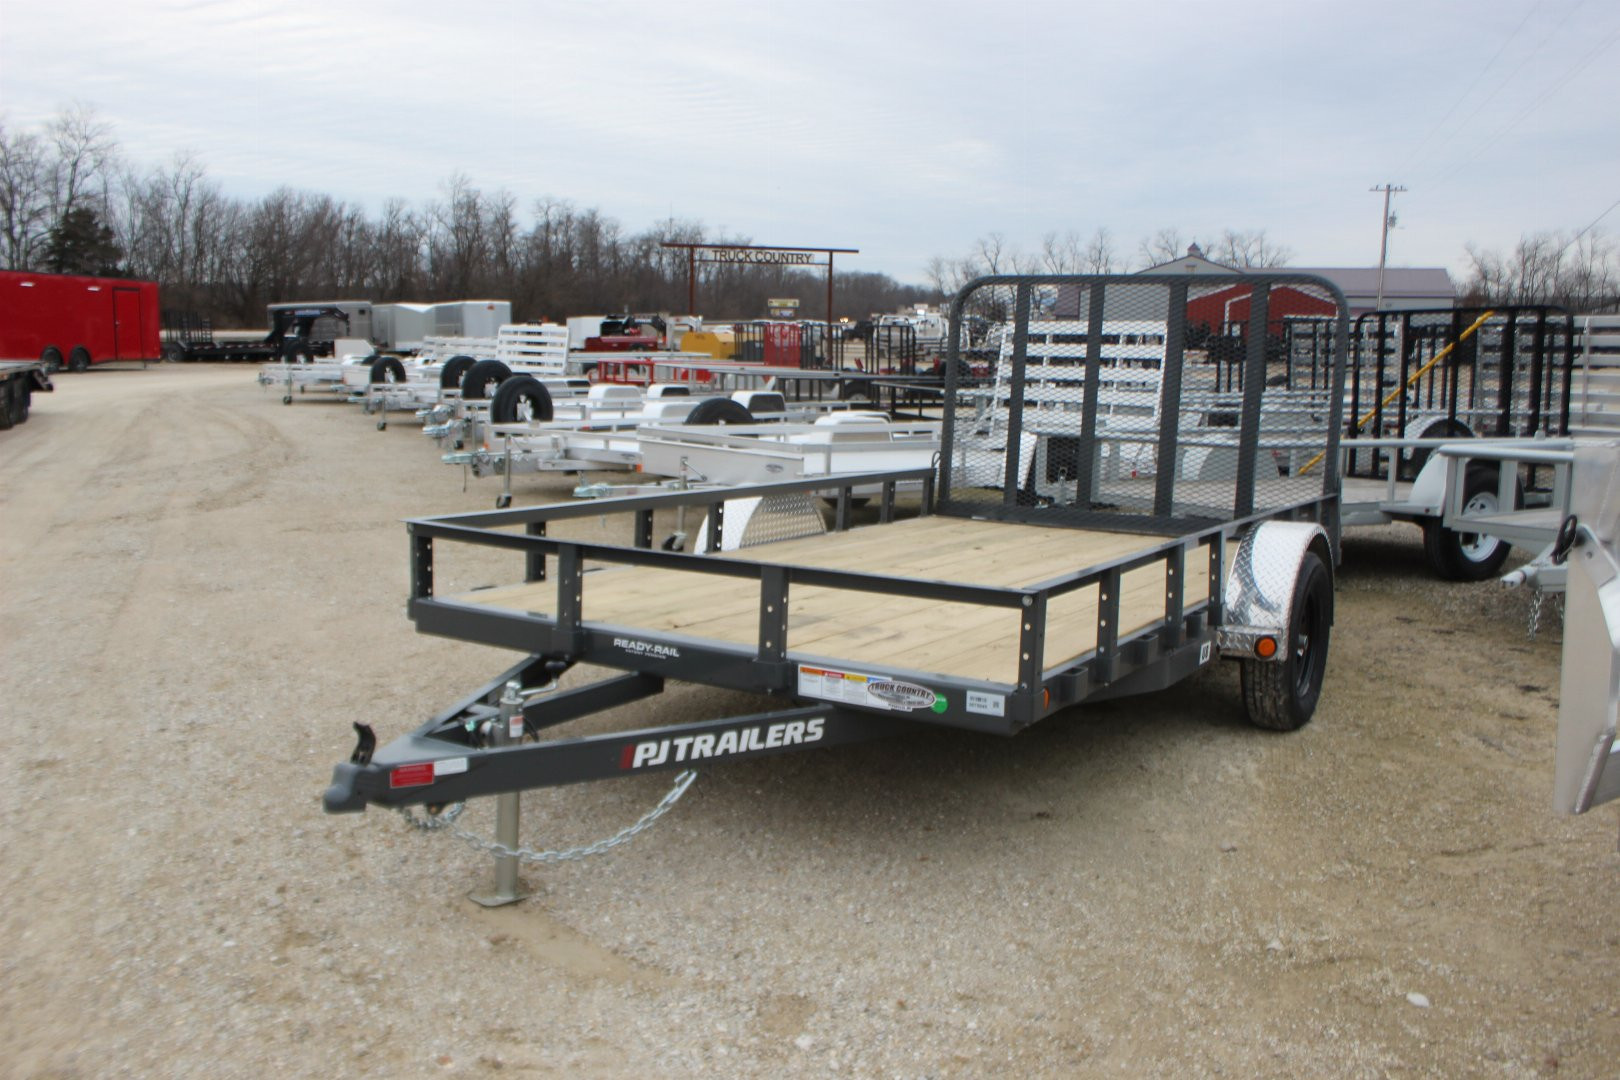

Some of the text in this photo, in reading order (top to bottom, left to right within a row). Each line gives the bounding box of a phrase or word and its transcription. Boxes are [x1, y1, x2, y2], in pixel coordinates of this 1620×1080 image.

[712, 250, 812, 263] TRUCK COUNTRY
[870, 682, 895, 691] TRUCK
[896, 684, 931, 698] COUNTRY
[673, 718, 825, 762] TRAILERS
